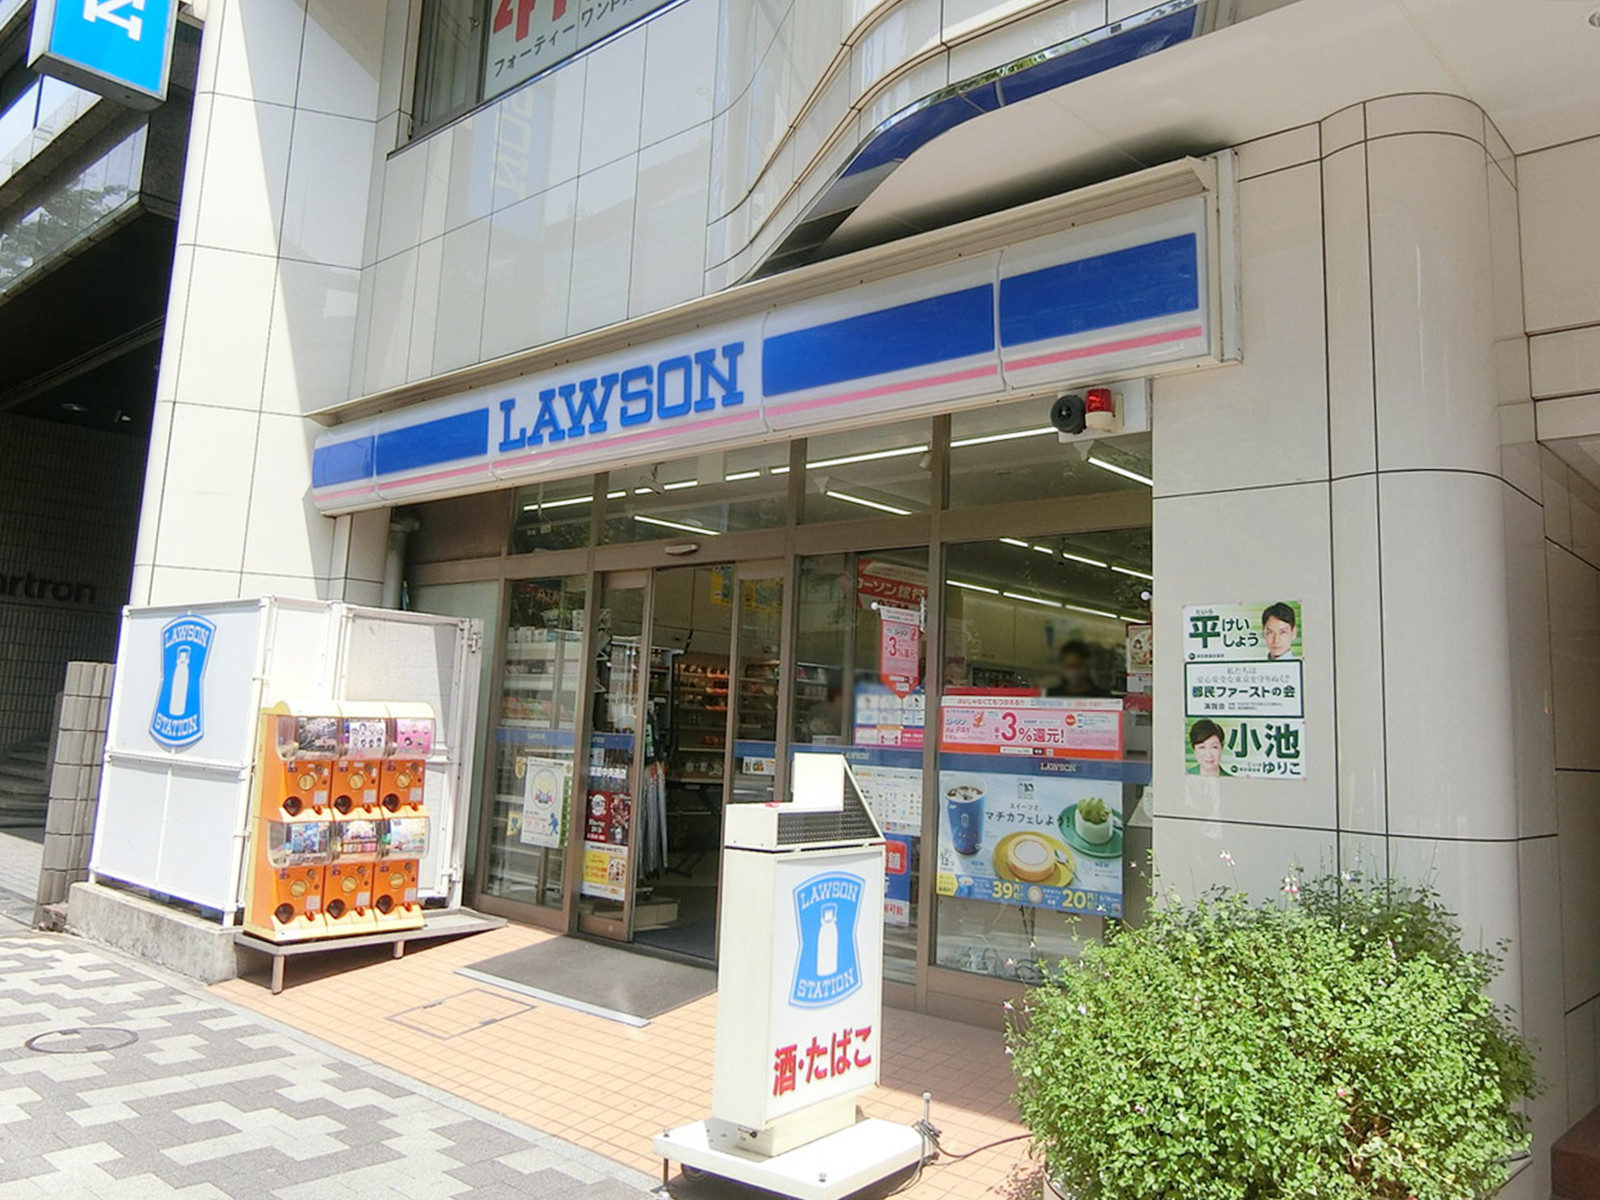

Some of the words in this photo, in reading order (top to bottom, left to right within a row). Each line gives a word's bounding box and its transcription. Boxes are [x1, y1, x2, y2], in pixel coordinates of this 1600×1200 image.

[498, 341, 745, 452] LAWSON
[164, 624, 209, 649] LAWSON
[1189, 615, 1221, 648] 平
[1222, 618, 1250, 632] けい
[1223, 632, 1259, 648] しょう
[1192, 685, 1296, 698] 都民ファーストの会
[155, 712, 199, 737] STATION
[1227, 722, 1301, 760] 小池
[1040, 762, 1077, 772] LAWSON
[1262, 761, 1301, 776] ゆりこ
[800, 881, 859, 910] LAWSON
[797, 968, 856, 999] STATION
[773, 1025, 872, 1097] 酒・たばこ
